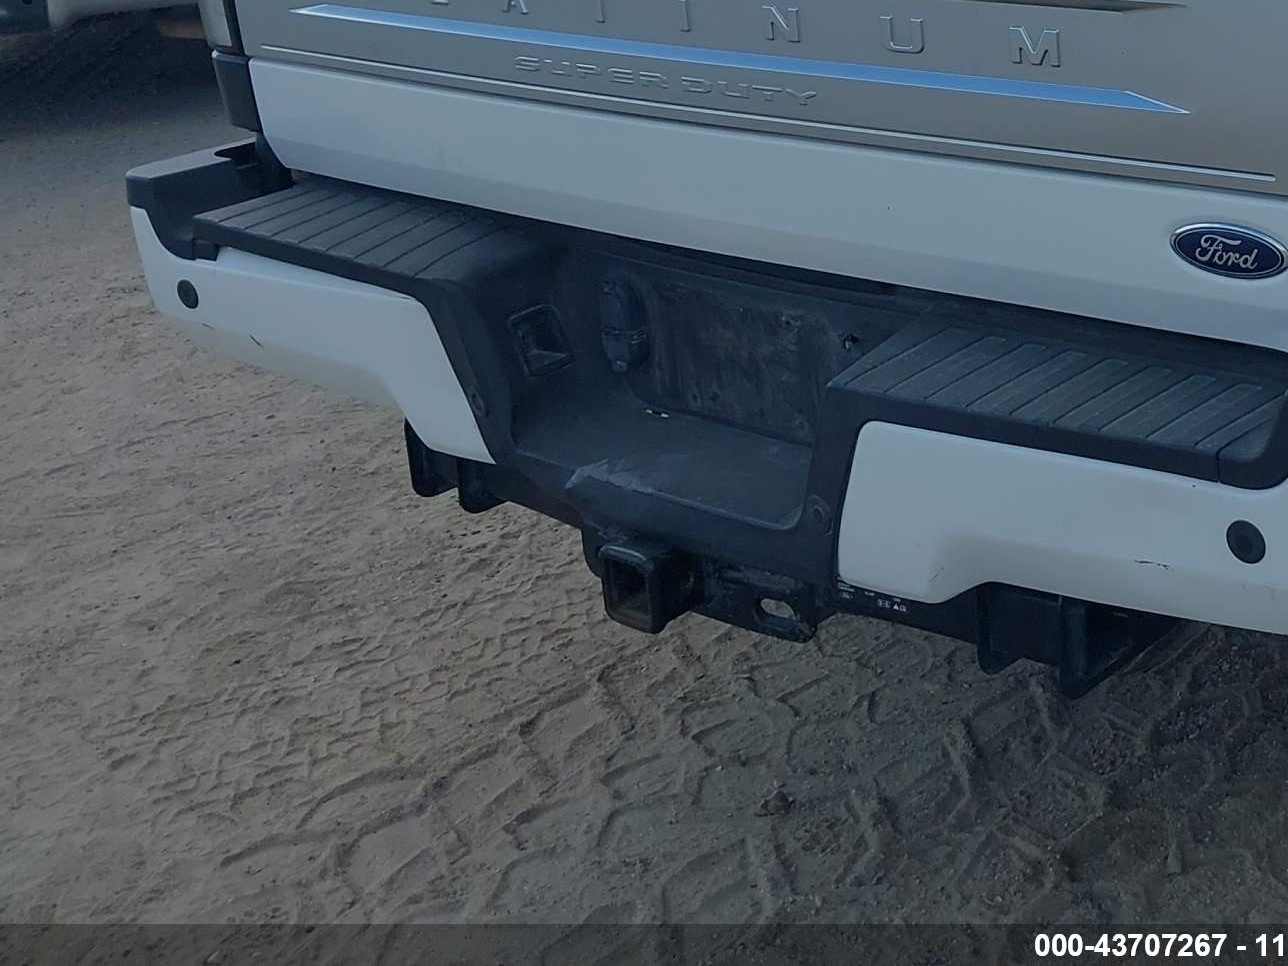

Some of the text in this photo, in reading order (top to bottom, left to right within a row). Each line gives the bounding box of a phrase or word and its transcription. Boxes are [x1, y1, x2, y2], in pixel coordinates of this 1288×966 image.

[514, 55, 817, 106] SUPER DUTY
[1195, 234, 1259, 269] Ford
